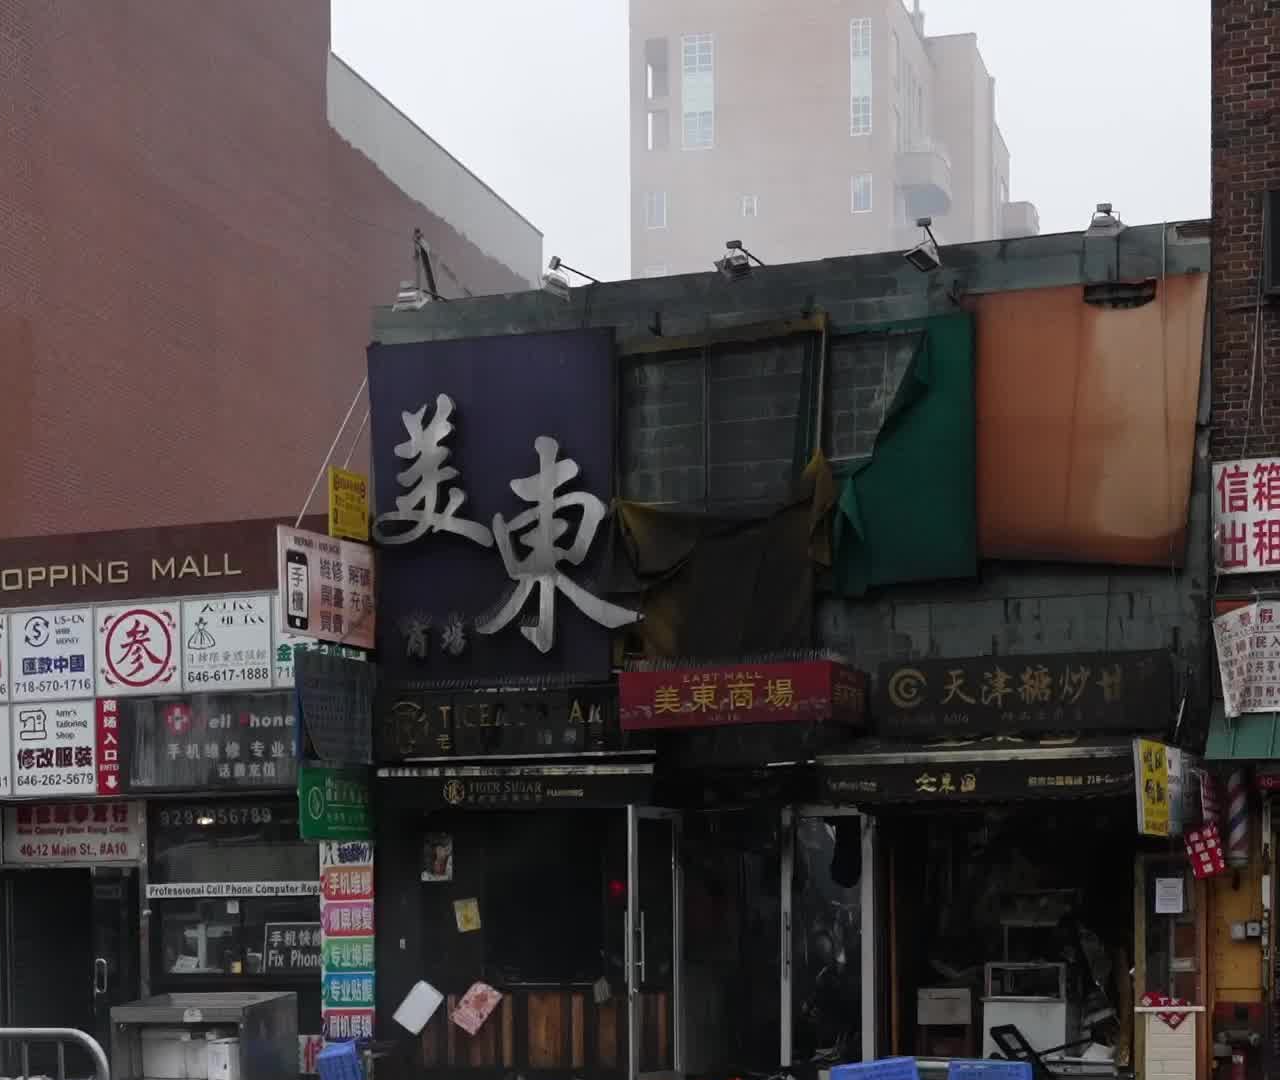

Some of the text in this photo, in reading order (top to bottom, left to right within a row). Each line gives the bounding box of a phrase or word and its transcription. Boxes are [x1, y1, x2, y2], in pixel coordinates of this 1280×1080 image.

[151, 554, 242, 581] MALL
[54, 615, 85, 625] US-CN
[188, 667, 269, 682] 646-617-1888
[15, 679, 91, 693] 718-570-1716
[655, 678, 795, 714] 美東商場
[17, 773, 94, 786] 646-262-5679
[51, 843, 77, 856] Main
[149, 884, 205, 897] Professional
[226, 884, 253, 895] Phone
[255, 883, 298, 896] Computer
[268, 951, 284, 967] Fix
